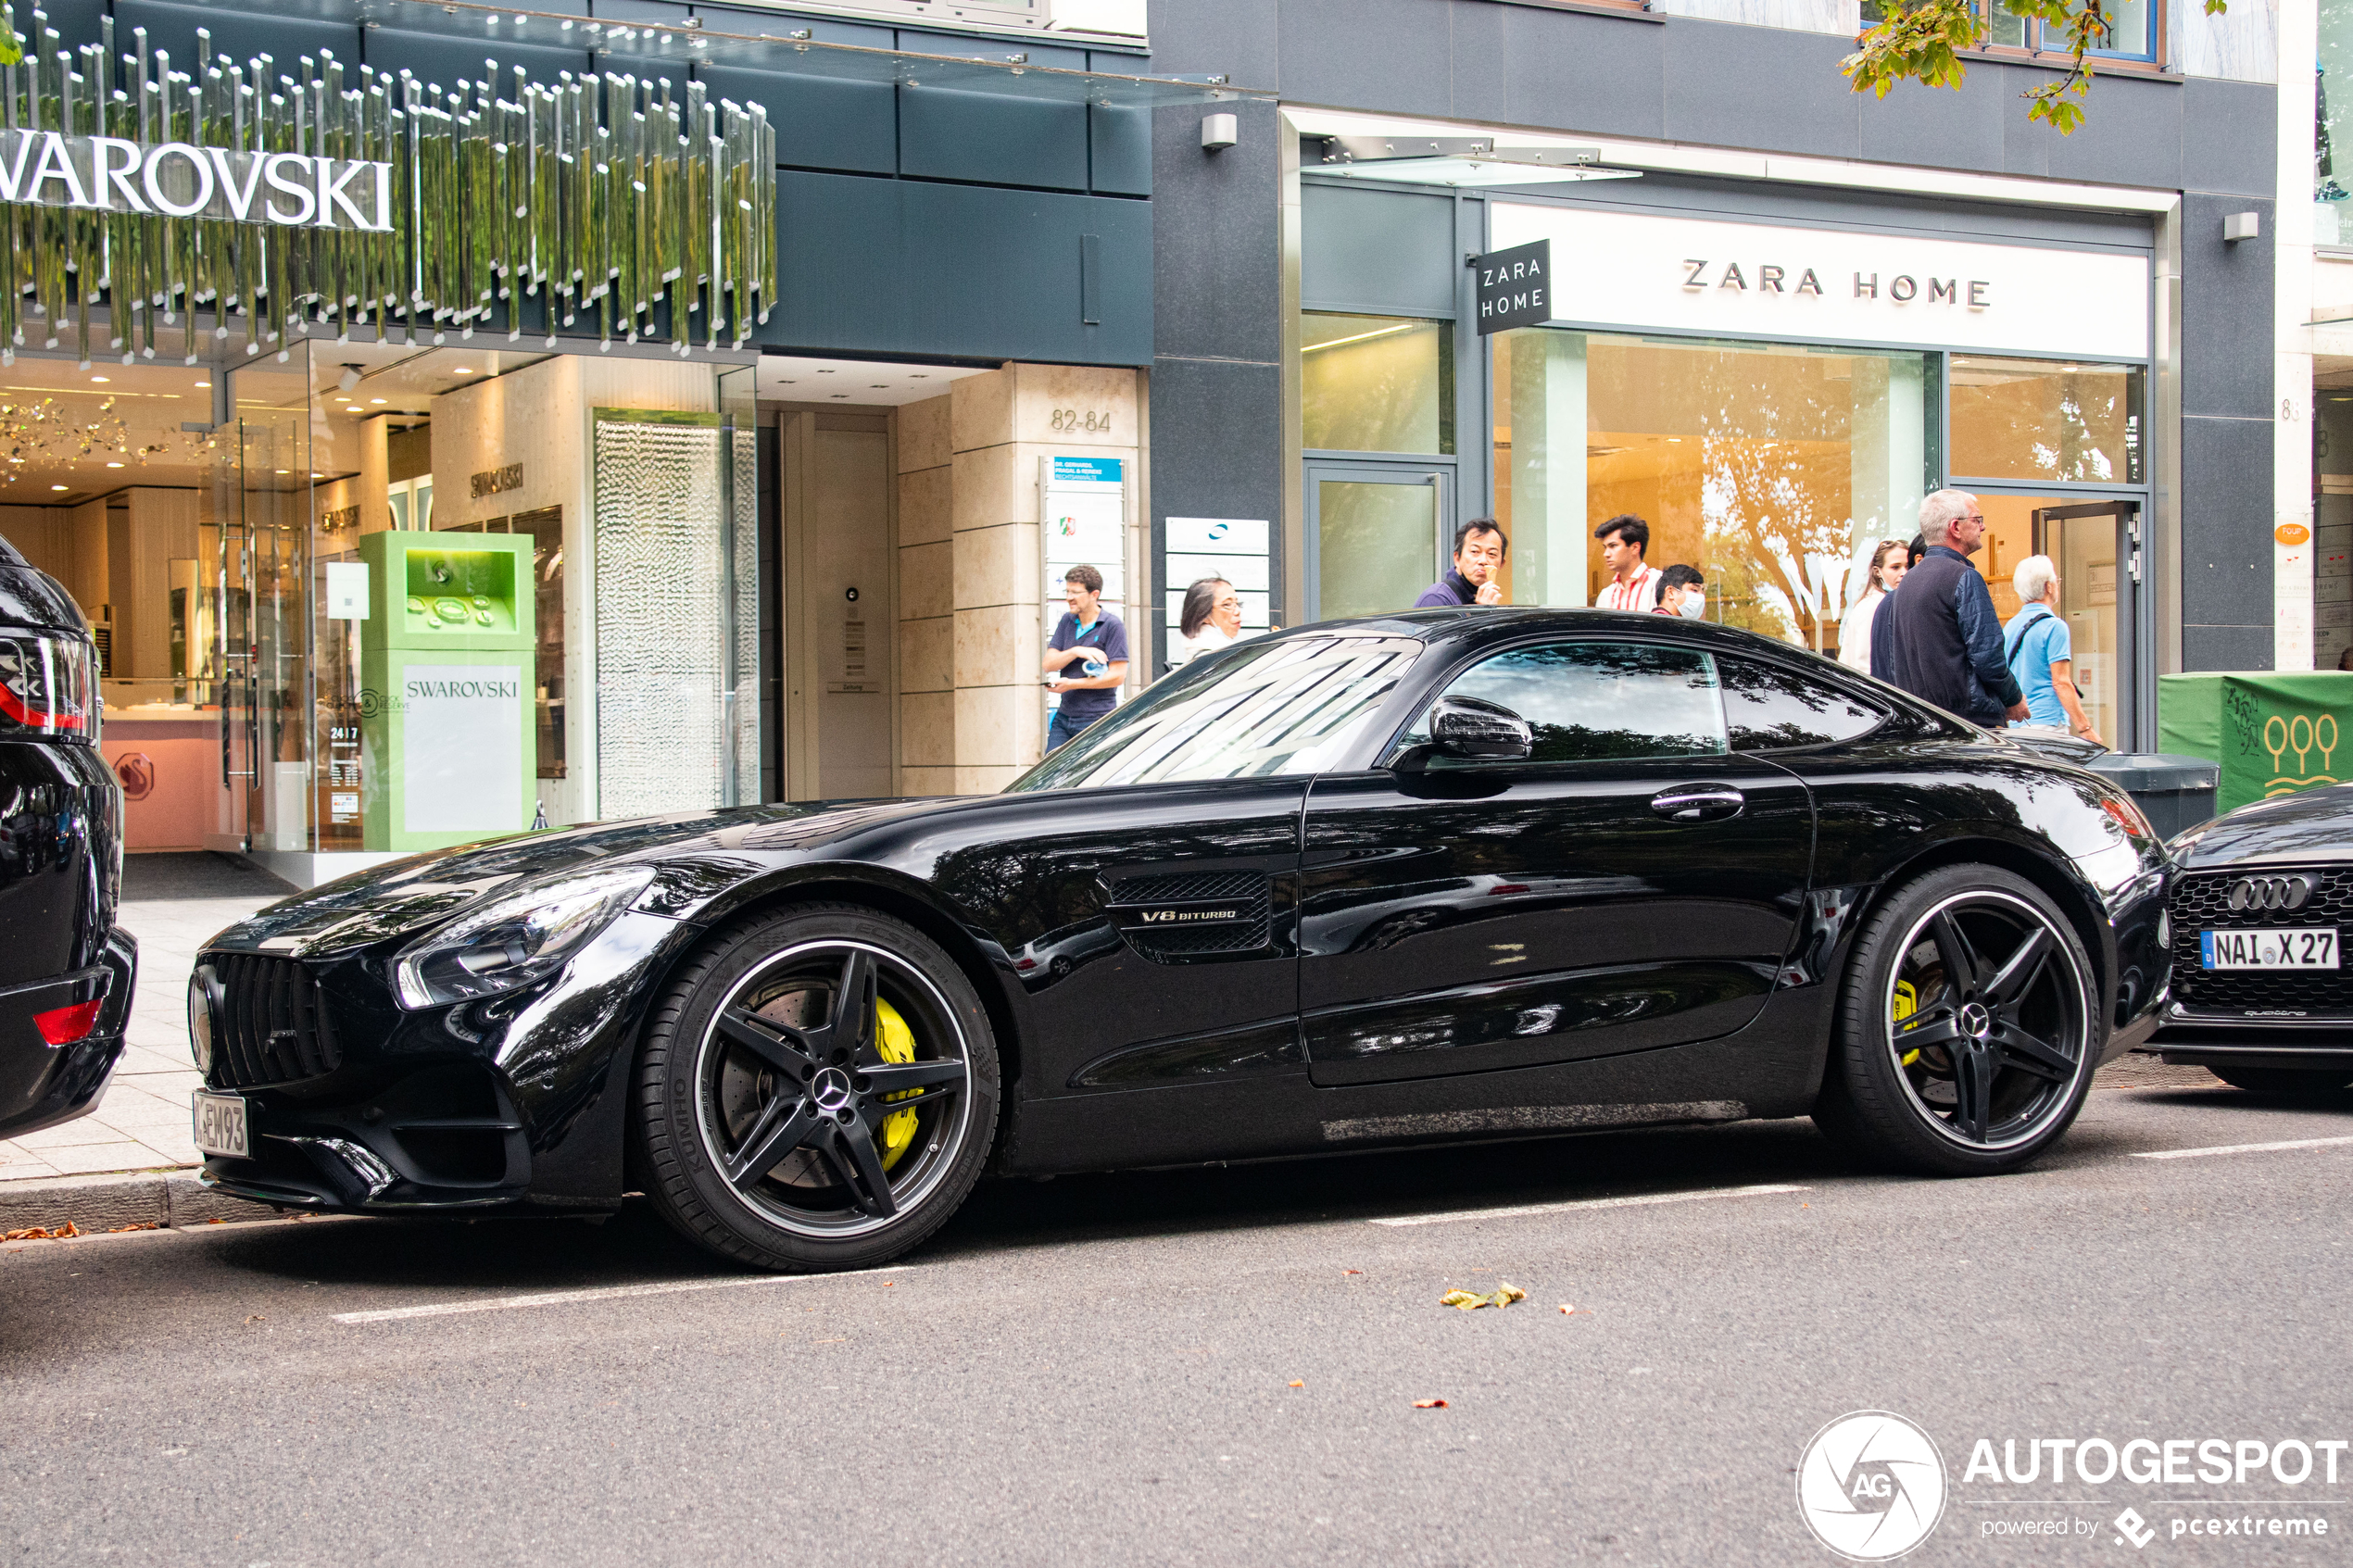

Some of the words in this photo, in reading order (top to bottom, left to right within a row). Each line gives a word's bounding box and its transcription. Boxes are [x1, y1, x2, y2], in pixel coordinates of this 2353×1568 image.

[1483, 258, 1541, 287] ZARA
[1681, 258, 1824, 295] ZARA
[1853, 271, 1991, 307] HOME
[1482, 288, 1543, 318] HOME
[1051, 408, 1111, 433] 82-84
[407, 681, 517, 698] SWAROVSKI
[1141, 910, 1176, 922] V8
[1178, 910, 1236, 921] BITURBO
[2206, 953, 2212, 962] D
[2215, 935, 2261, 965] NAI
[674, 1078, 705, 1174] KUMHO
